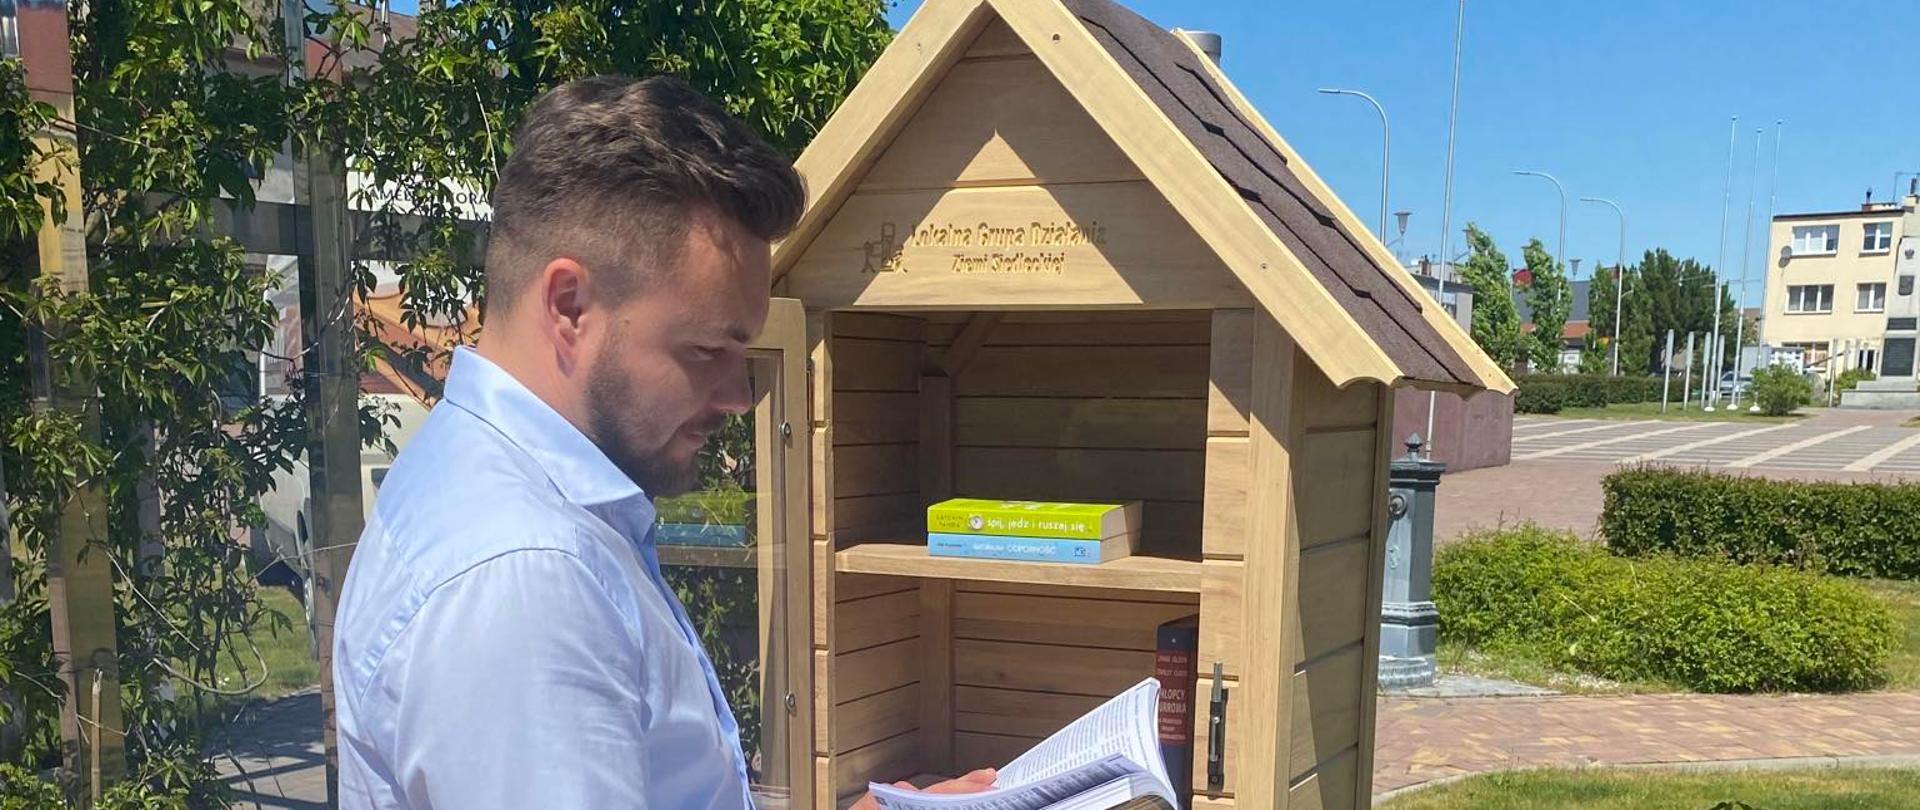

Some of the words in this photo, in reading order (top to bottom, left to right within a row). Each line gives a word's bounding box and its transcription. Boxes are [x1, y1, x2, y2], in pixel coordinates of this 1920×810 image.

[911, 223, 972, 247] Lokalna
[978, 222, 1025, 251] Grupa
[1030, 221, 1107, 247] Działania
[952, 253, 988, 273] Ziemi
[991, 252, 1064, 275] Siedleckiej
[1039, 520, 1067, 534] ruszaj
